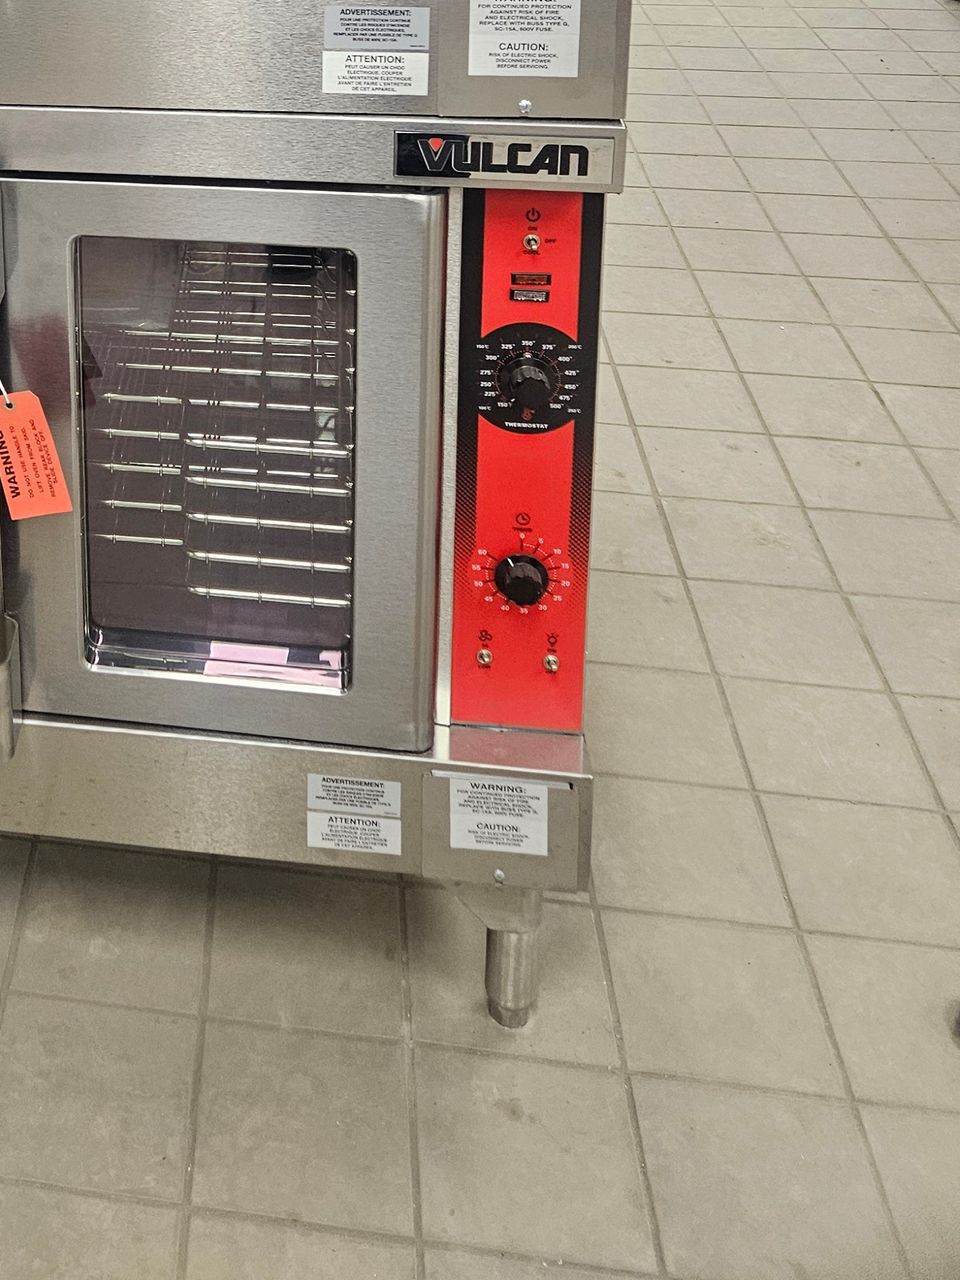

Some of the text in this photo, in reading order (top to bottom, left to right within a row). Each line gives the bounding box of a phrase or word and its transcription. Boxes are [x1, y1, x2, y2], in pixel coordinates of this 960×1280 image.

[499, 42, 549, 51] CAUTION:
[346, 55, 405, 63] ATTENTION:
[417, 138, 589, 176] VULCAN
[504, 421, 548, 429] THERMOSTAT
[28, 419, 57, 498] REMOVE REAR BLOCK AND
[42, 444, 53, 465] DEVICE
[9, 425, 35, 498] DO NOT USE HANDLE TO
[25, 443, 45, 493] LIFT OVEN FROM
[470, 782, 526, 794] WARNING:
[328, 816, 381, 827] ATTENTION:
[476, 822, 521, 832] CAUTION:
